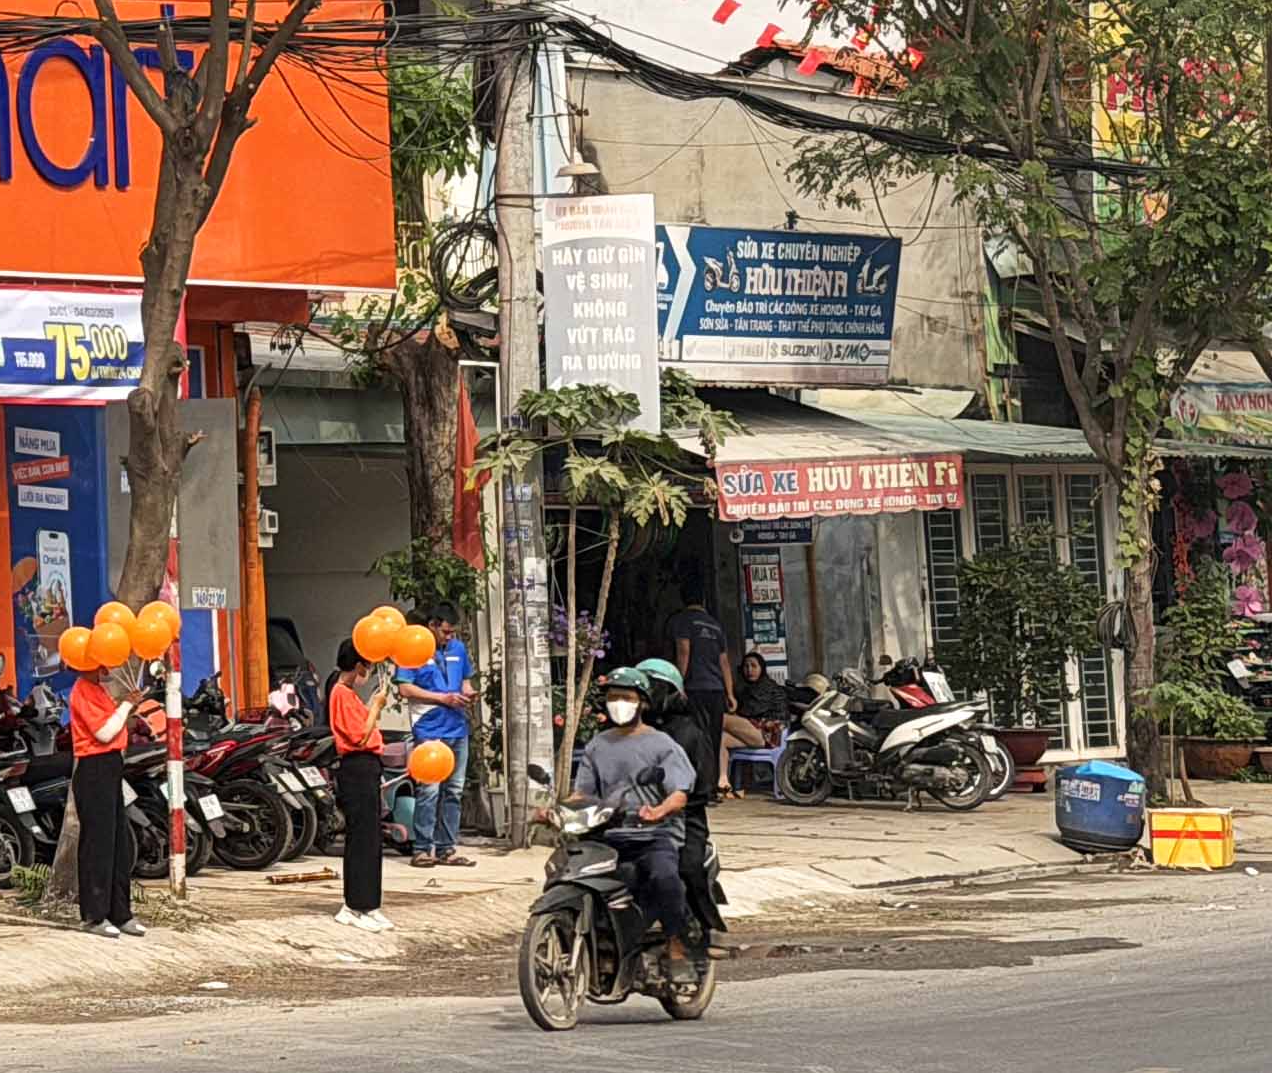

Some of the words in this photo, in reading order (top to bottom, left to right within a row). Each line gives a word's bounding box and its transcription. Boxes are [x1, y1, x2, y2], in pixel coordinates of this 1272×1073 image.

[552, 246, 583, 266] HÃY
[587, 245, 616, 265] GIỮ
[618, 244, 646, 265] GÌN
[737, 235, 759, 258] SỬA
[761, 242, 775, 260] XE
[777, 240, 819, 261] CHUYÊN
[822, 242, 861, 266] NGHIỆP
[566, 271, 586, 293] VỆ
[573, 298, 627, 318] KHÔNG
[705, 300, 735, 317] Chuyên
[769, 299, 784, 314] CÁC
[809, 303, 820, 315] XE
[821, 304, 848, 316] HONDA
[855, 304, 869, 316] TAY
[870, 304, 882, 317] GA
[567, 323, 599, 344] VỨT
[603, 323, 636, 344] RÁC
[44, 320, 128, 381] 75.000
[562, 354, 583, 370] RA
[587, 350, 641, 370] ĐƯỜNG
[781, 346, 819, 357] SUZUKI
[723, 464, 766, 496] SỬA
[772, 470, 799, 495] XE
[858, 458, 929, 493] THIỆN
